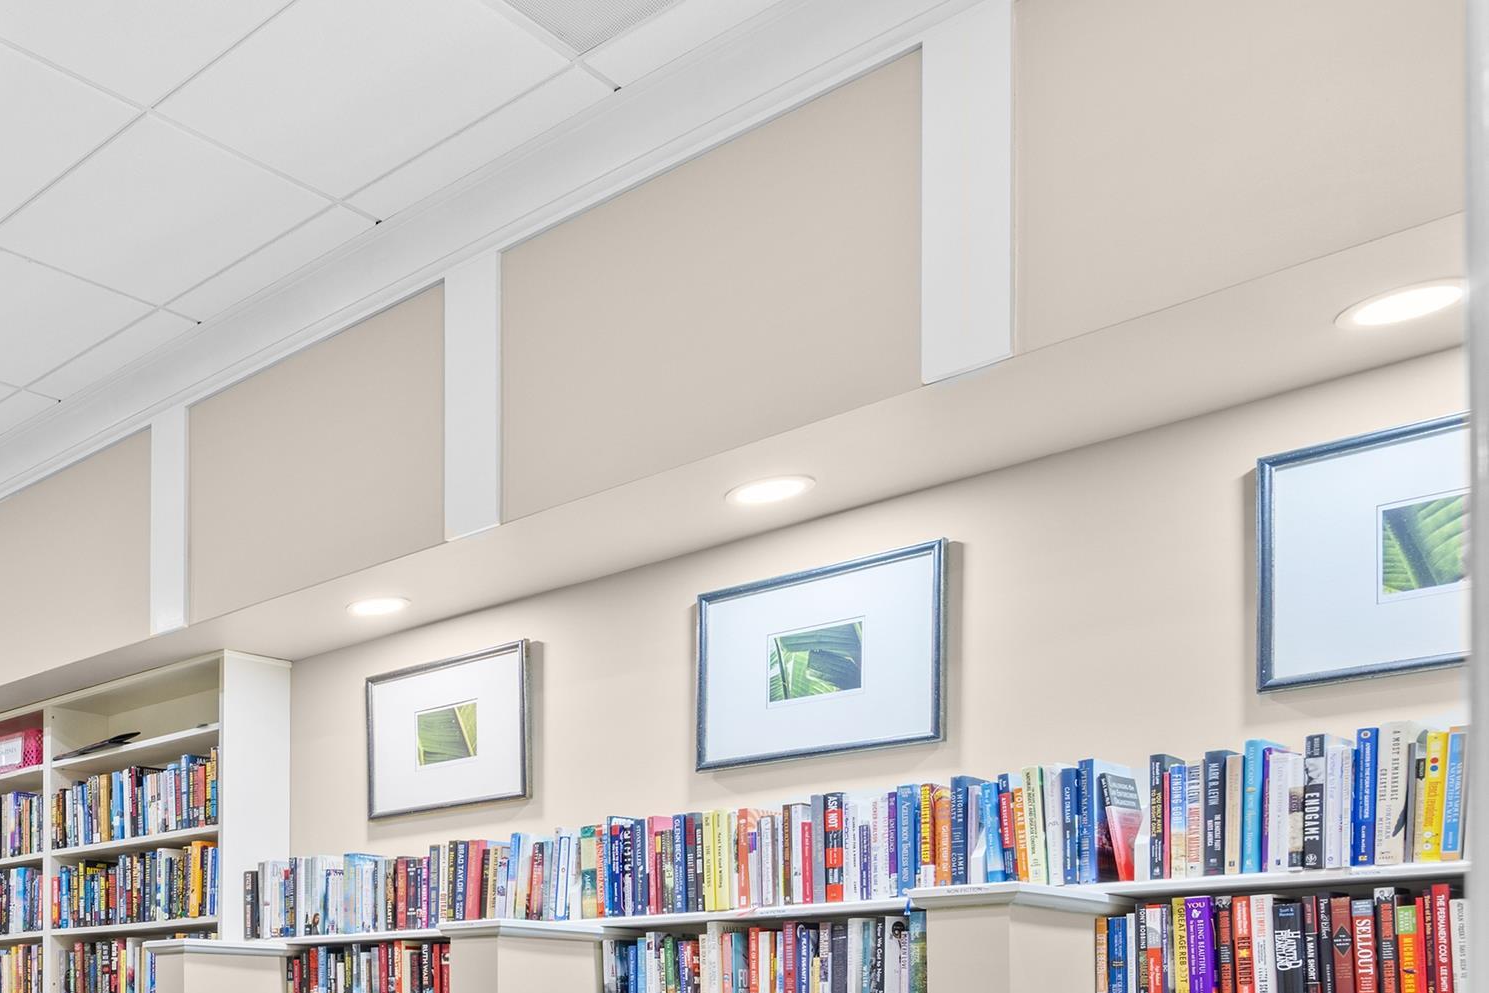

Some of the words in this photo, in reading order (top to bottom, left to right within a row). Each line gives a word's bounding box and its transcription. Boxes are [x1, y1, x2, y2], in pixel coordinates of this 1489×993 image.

[1392, 737, 1400, 755] MOST
[1208, 762, 1219, 780] MARK
[1390, 758, 1400, 801] REMARKABLE
[1173, 774, 1182, 804] FINDING
[1378, 768, 1388, 802] CREATURE
[828, 796, 838, 811] ASK
[921, 786, 930, 823] SOCIALISTS
[1208, 789, 1219, 806] LEVIN
[828, 813, 838, 828] NOT
[1173, 806, 1183, 824] GOBI
[1188, 807, 1201, 836] AMERICAN
[1304, 792, 1320, 842] ENDGAME
[1384, 804, 1392, 840] JONATHAN
[921, 824, 930, 842] DON'T
[921, 843, 930, 862] SLEEP
[1188, 836, 1201, 864] MARXISM
[1254, 898, 1265, 916] SECRET
[1436, 894, 1445, 907] THE
[1177, 907, 1185, 933] GREAT
[1196, 919, 1204, 940] BEING
[1437, 907, 1447, 944] PERMANENT
[877, 937, 882, 947] We
[1178, 934, 1187, 950] AGE
[1237, 936, 1250, 950] RED
[1274, 929, 1290, 971] HEARTLAND
[1288, 930, 1303, 969] HAUNTED
[1307, 942, 1315, 958] MAN
[1355, 919, 1374, 975] SELLOUT
[1197, 941, 1206, 975] BEAUTIFUL
[1403, 937, 1414, 969] MICHAEL
[1438, 944, 1448, 963] COUP
[1238, 957, 1253, 986] HANDED
[1308, 959, 1316, 980] SHORT
[1439, 966, 1447, 976] LEE
[1440, 976, 1448, 992] SMITH
